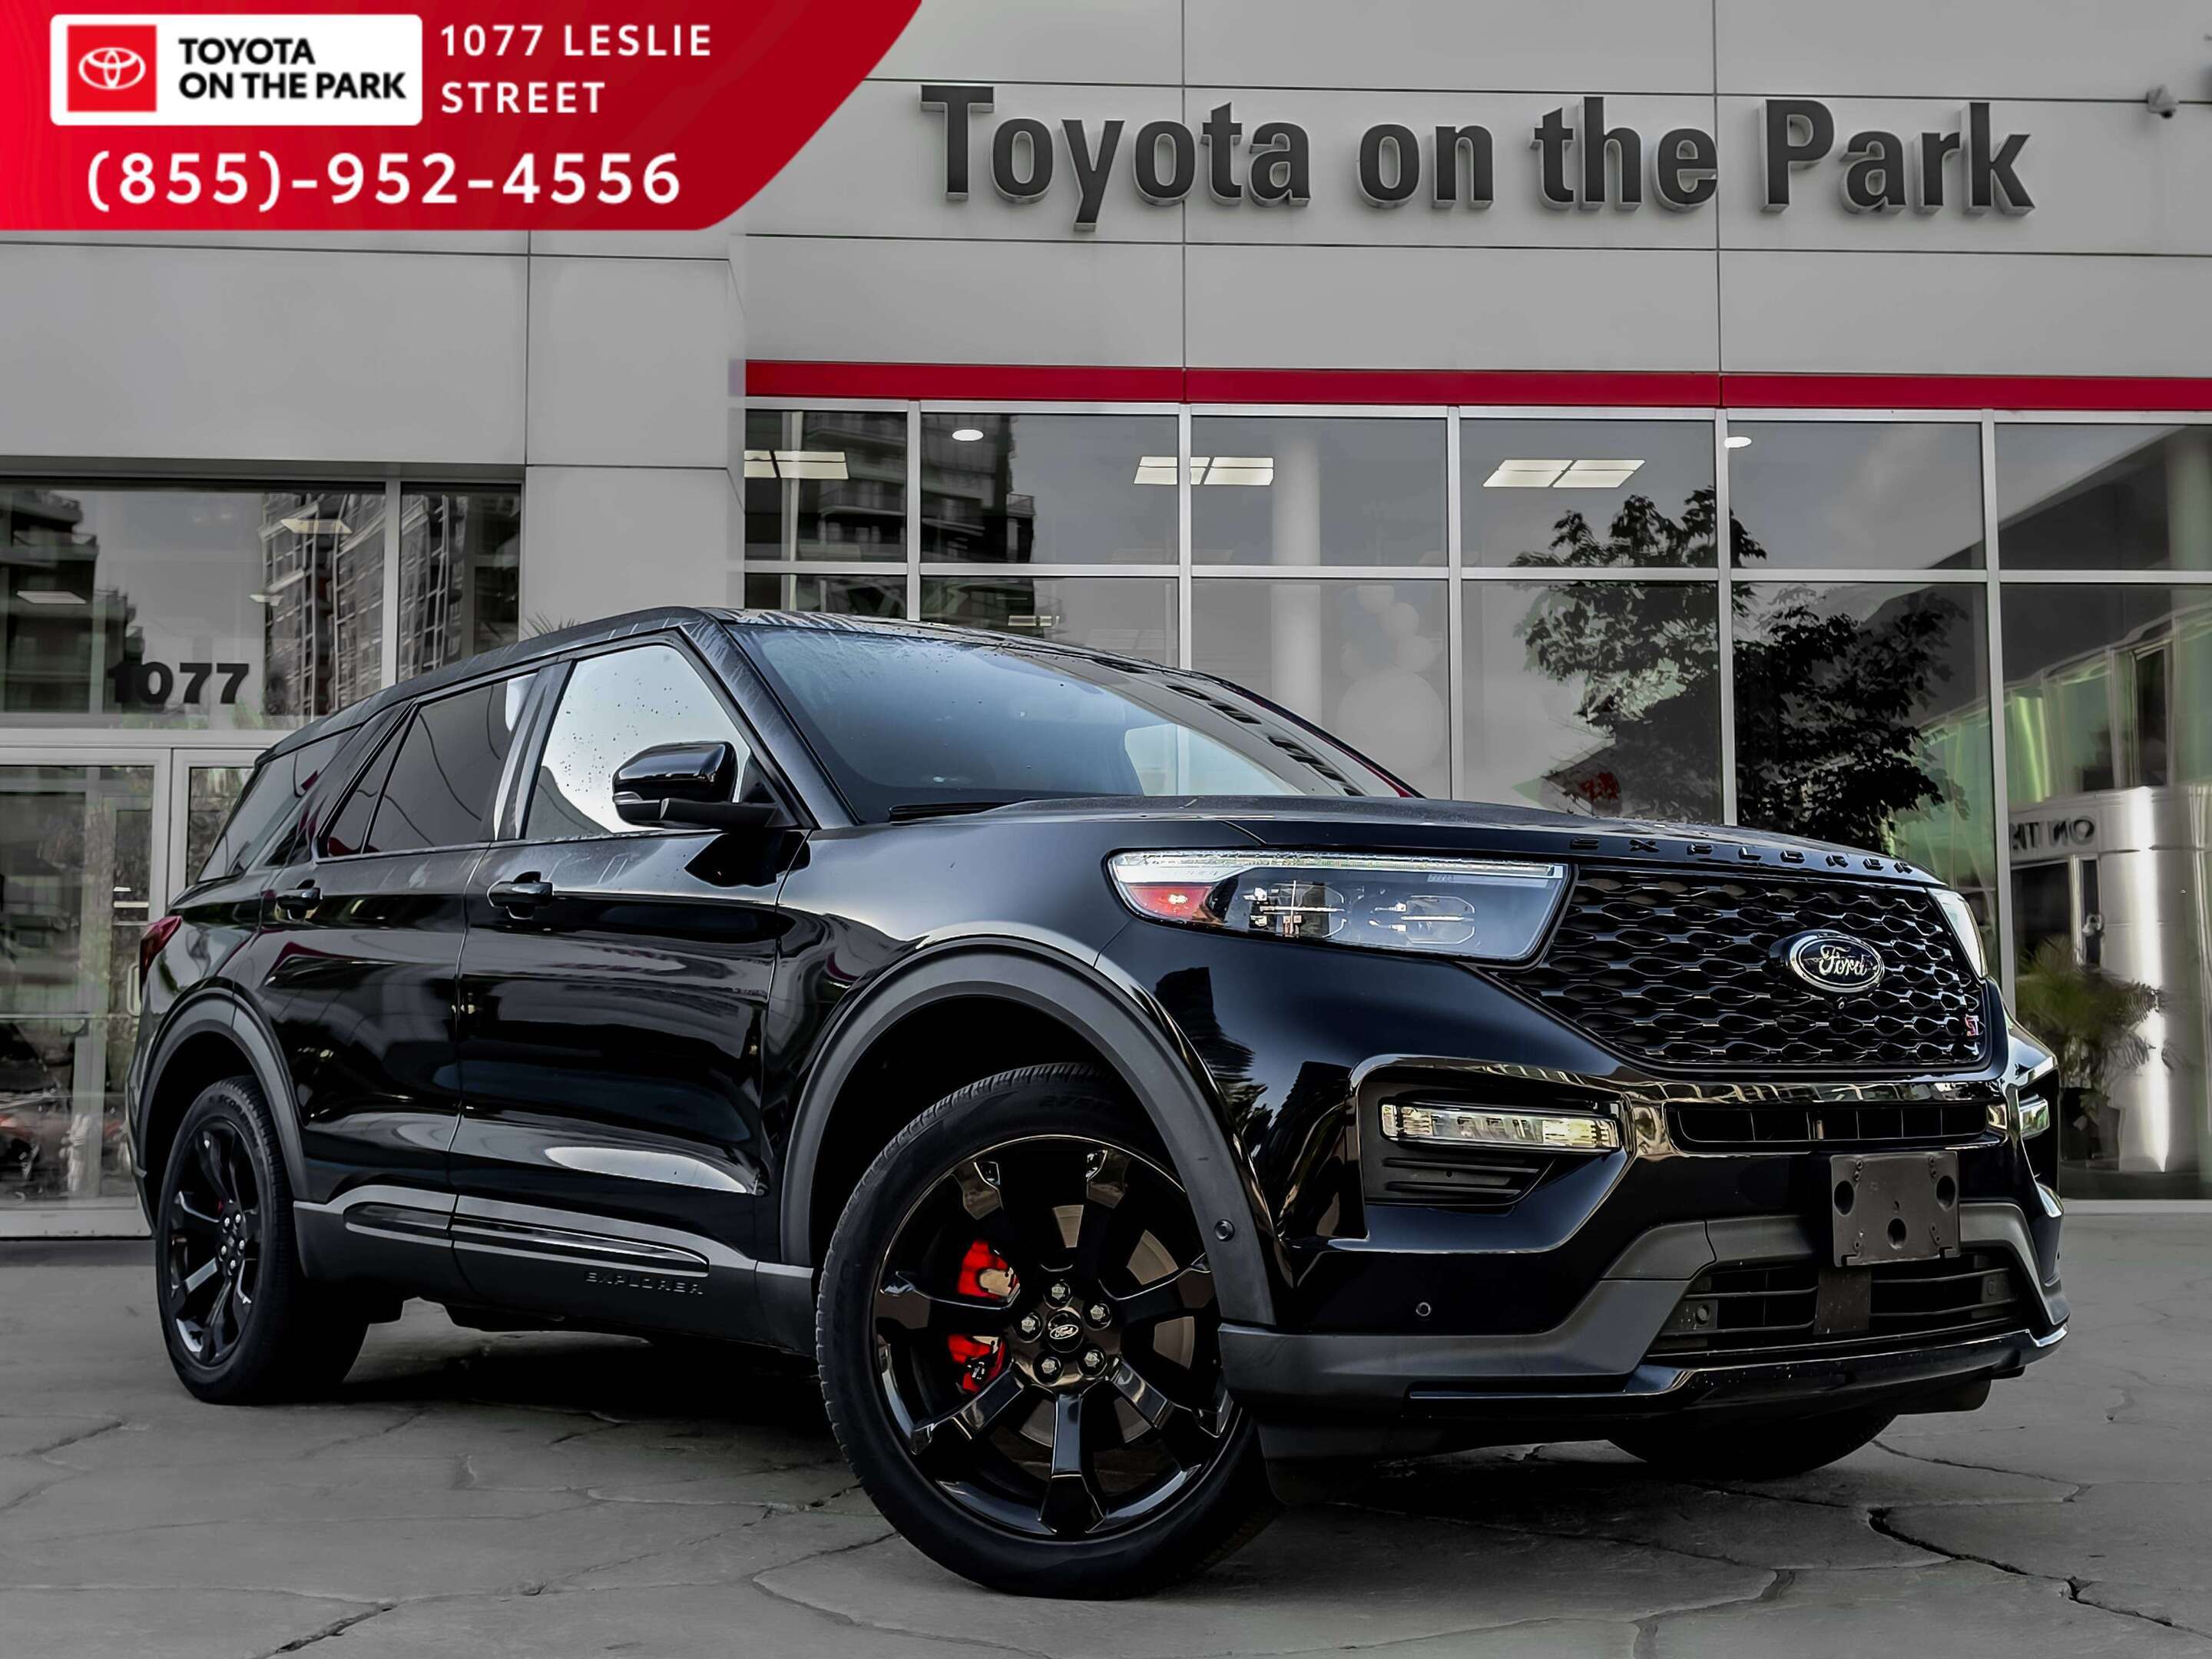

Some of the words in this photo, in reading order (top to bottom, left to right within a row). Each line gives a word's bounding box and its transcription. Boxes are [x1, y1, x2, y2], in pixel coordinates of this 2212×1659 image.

[920, 84, 1312, 231] Toyota
[1356, 123, 1495, 210] on
[1531, 96, 1719, 213] the
[1760, 98, 2036, 217] Park
[107, 661, 250, 704] 1077
[1569, 836, 1913, 875] EXPLORER
[1818, 944, 1873, 976] Ford
[1965, 1013, 1980, 1036] ST
[585, 1271, 704, 1295] EXPLORER
